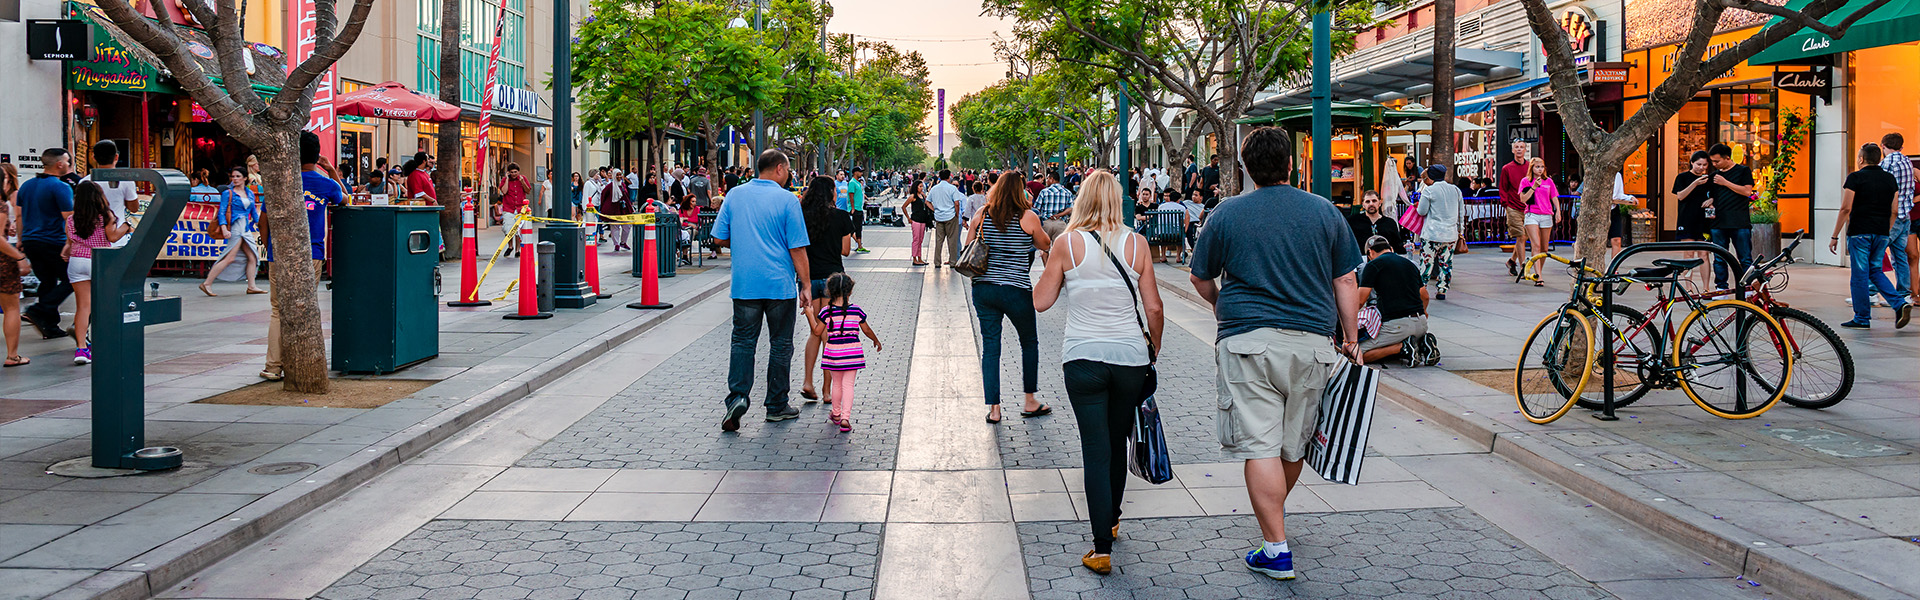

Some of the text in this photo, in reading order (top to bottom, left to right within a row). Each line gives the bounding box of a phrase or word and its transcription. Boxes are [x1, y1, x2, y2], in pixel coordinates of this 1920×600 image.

[1801, 37, 1830, 52] Clarks
[72, 66, 148, 89] Margaritas
[1778, 73, 1826, 87] Clarks
[499, 84, 539, 115] OLD NAVY
[1510, 127, 1537, 139] ATM
[1457, 165, 1478, 177] ORDER
[304, 190, 325, 205] Park
[167, 232, 178, 244] 2
